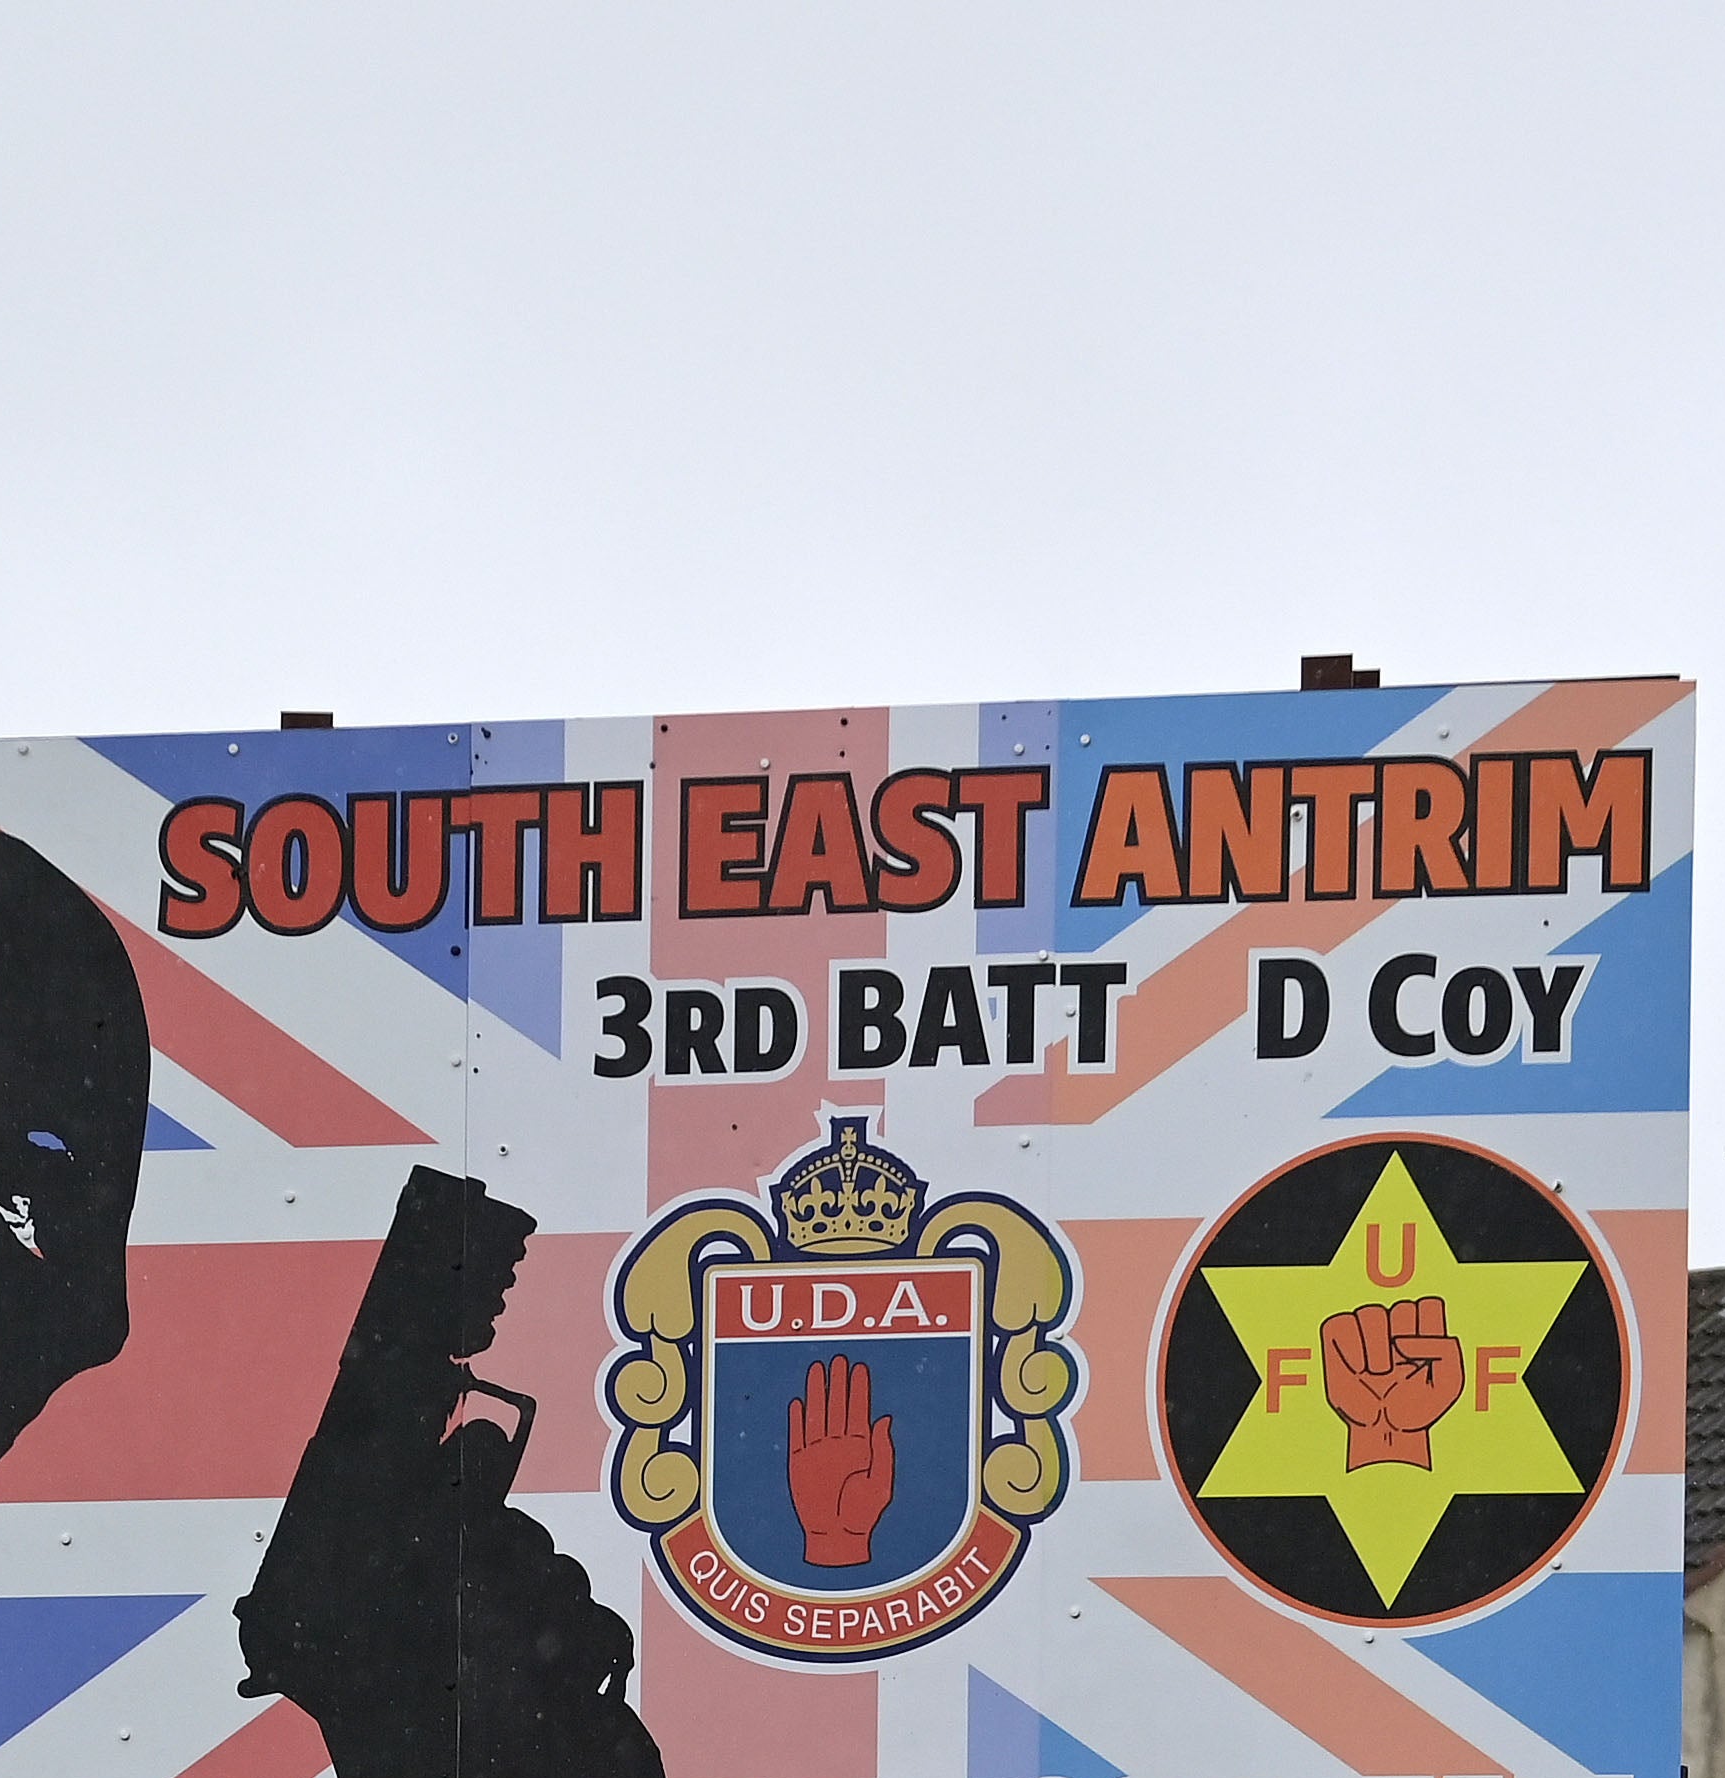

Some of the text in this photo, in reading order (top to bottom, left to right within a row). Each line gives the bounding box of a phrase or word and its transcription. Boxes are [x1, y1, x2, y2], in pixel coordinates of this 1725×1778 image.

[158, 748, 1653, 939] SOUTH EAST ANTRIM
[593, 975, 798, 1078] 3RD
[837, 962, 1127, 1070] BATT
[1256, 958, 1330, 1060] D
[1366, 1222, 1416, 1288] U
[740, 1280, 948, 1331] U.D.A.
[689, 1546, 991, 1640] QUIS SEPARABIT
